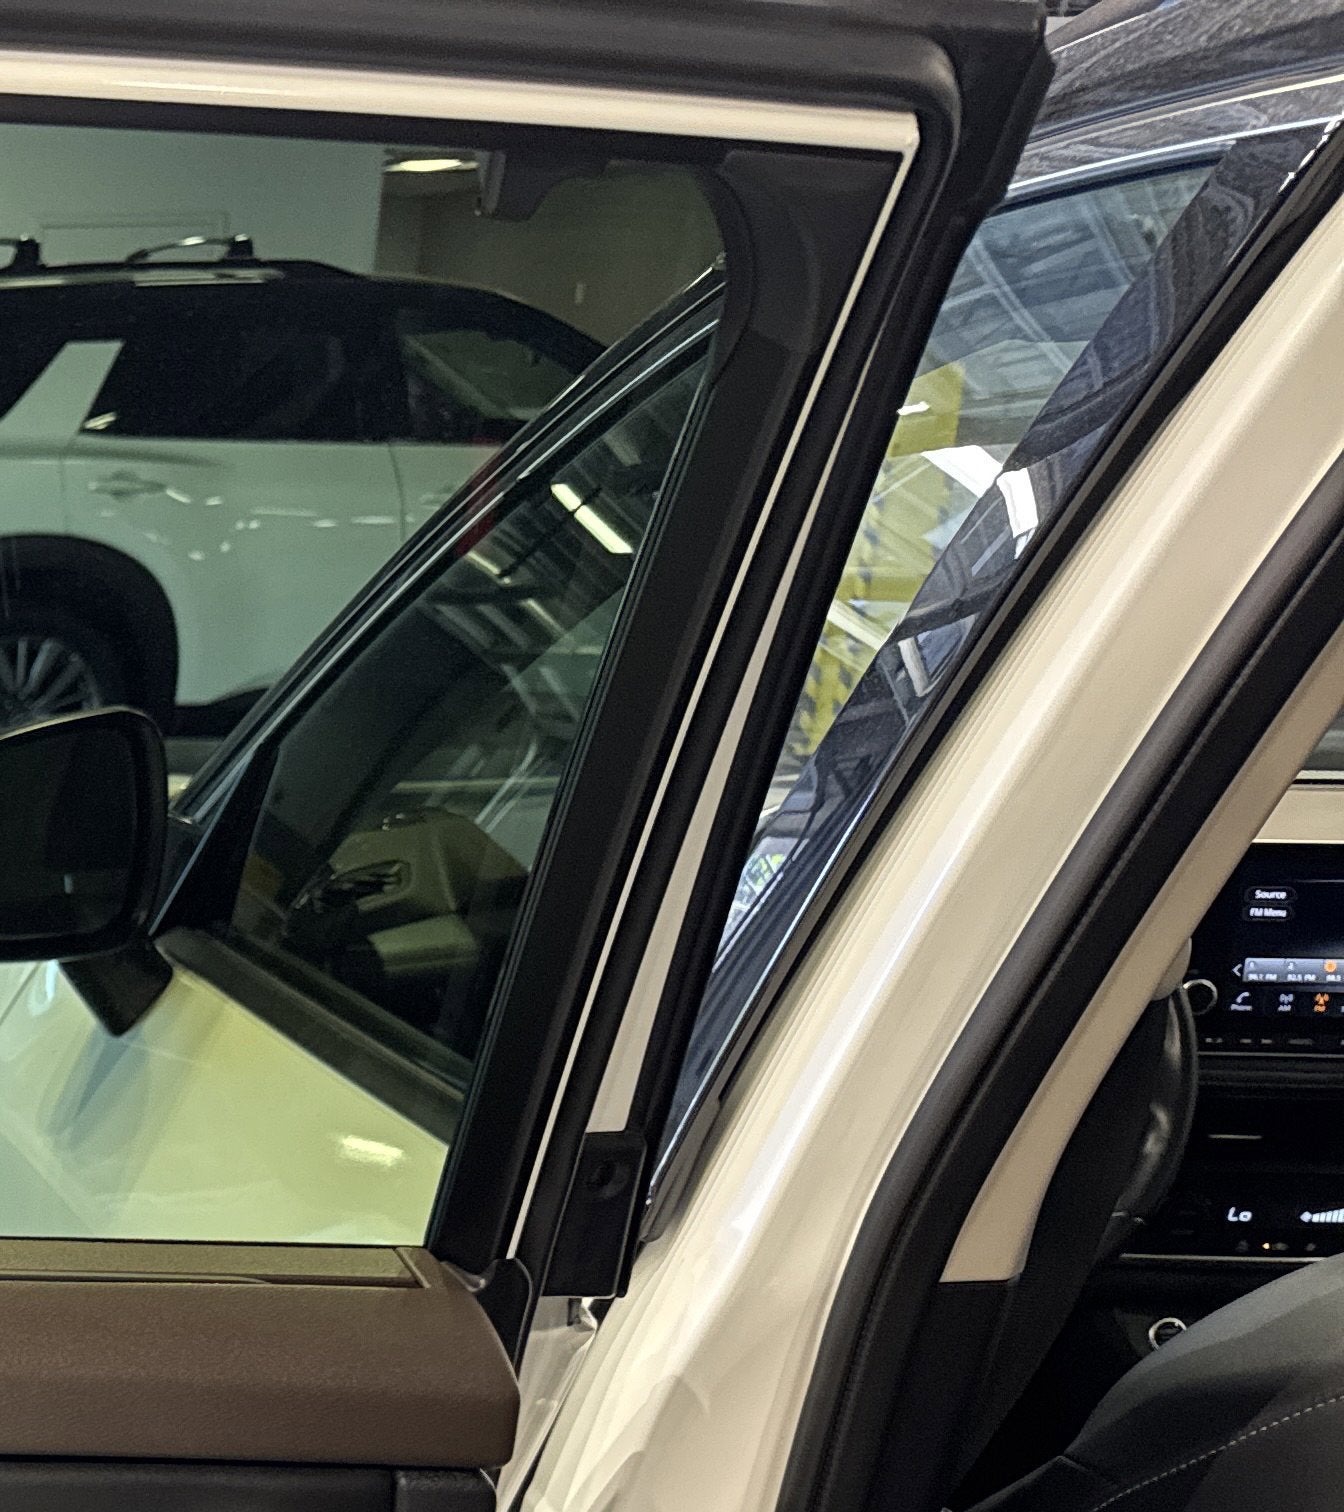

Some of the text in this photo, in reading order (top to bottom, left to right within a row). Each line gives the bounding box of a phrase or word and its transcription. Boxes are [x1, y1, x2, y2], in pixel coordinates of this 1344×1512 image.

[1254, 889, 1287, 899] Source
[1263, 907, 1287, 917] Menu
[1226, 1206, 1254, 1222] Lo
